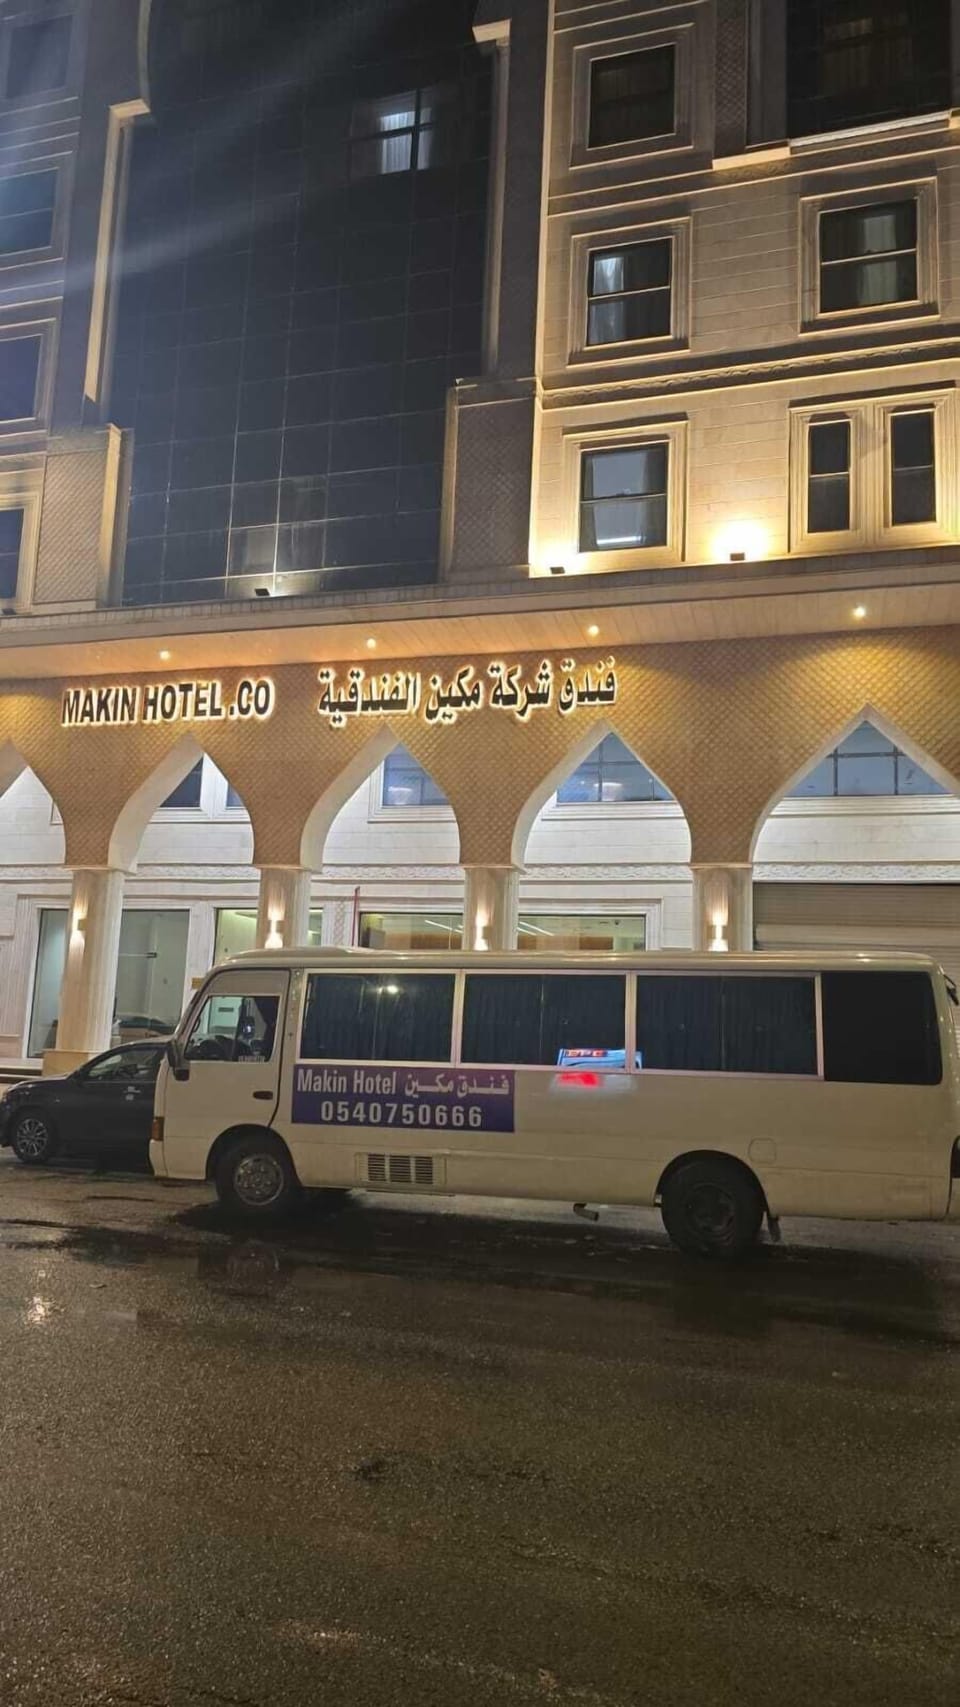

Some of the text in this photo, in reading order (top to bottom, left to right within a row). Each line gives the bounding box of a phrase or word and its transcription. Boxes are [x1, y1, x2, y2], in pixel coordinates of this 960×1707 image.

[62, 679, 273, 724] MAKIN HOTEL .CO
[319, 657, 616, 726] فندق شركة مكين الفندقية
[297, 1069, 397, 1095] Makin Hotel
[405, 1073, 509, 1098] فندق مكين
[321, 1101, 482, 1127] 0540750666
